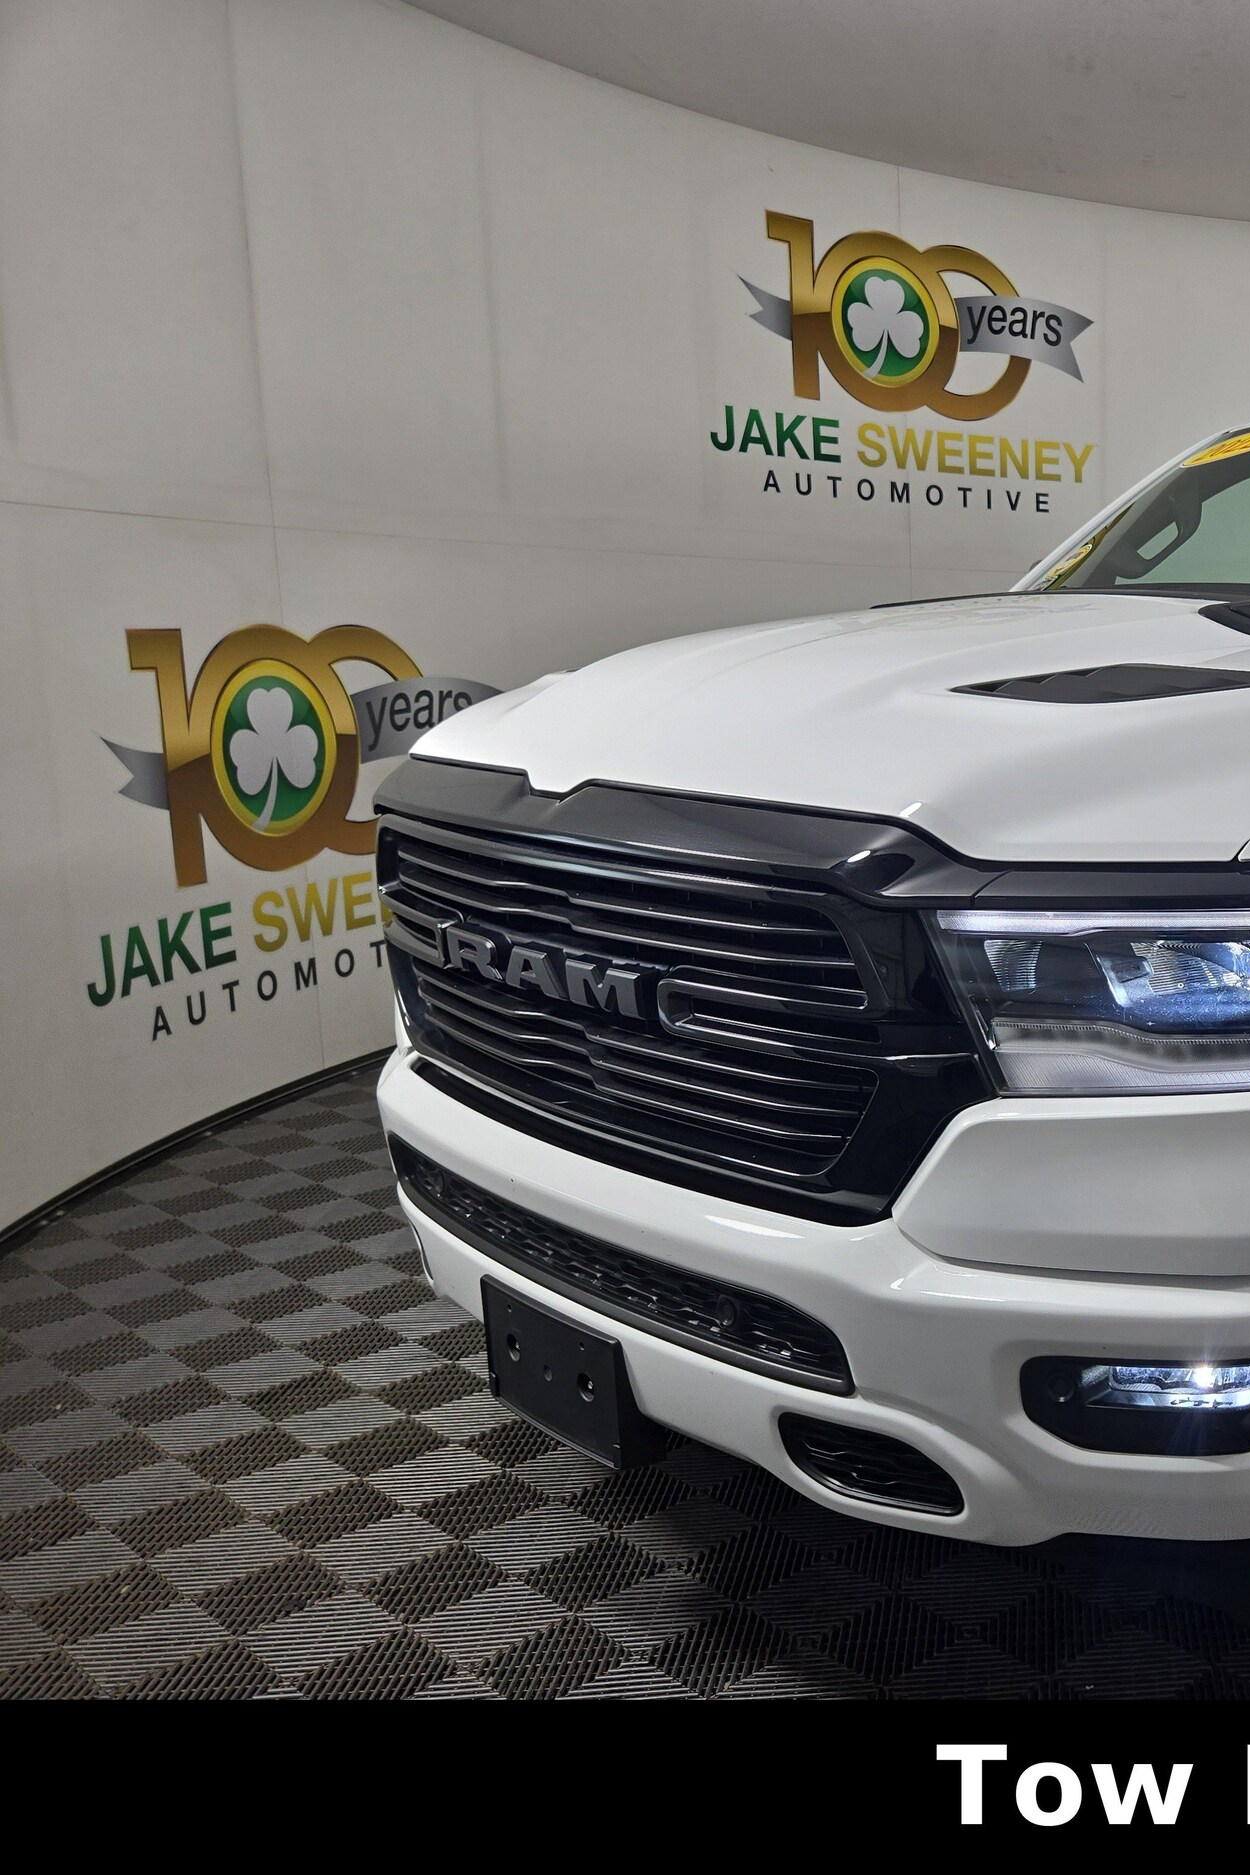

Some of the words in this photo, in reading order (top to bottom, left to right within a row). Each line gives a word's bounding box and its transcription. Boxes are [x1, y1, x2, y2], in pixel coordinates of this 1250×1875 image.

[765, 209, 1032, 422] 100
[967, 304, 1064, 347] years
[710, 405, 842, 463] JAKE
[857, 423, 1095, 484] SWEENEY
[763, 470, 1050, 513] AUTOMOTIVE
[87, 901, 238, 1007] JAKE
[446, 926, 646, 1019] RAM
